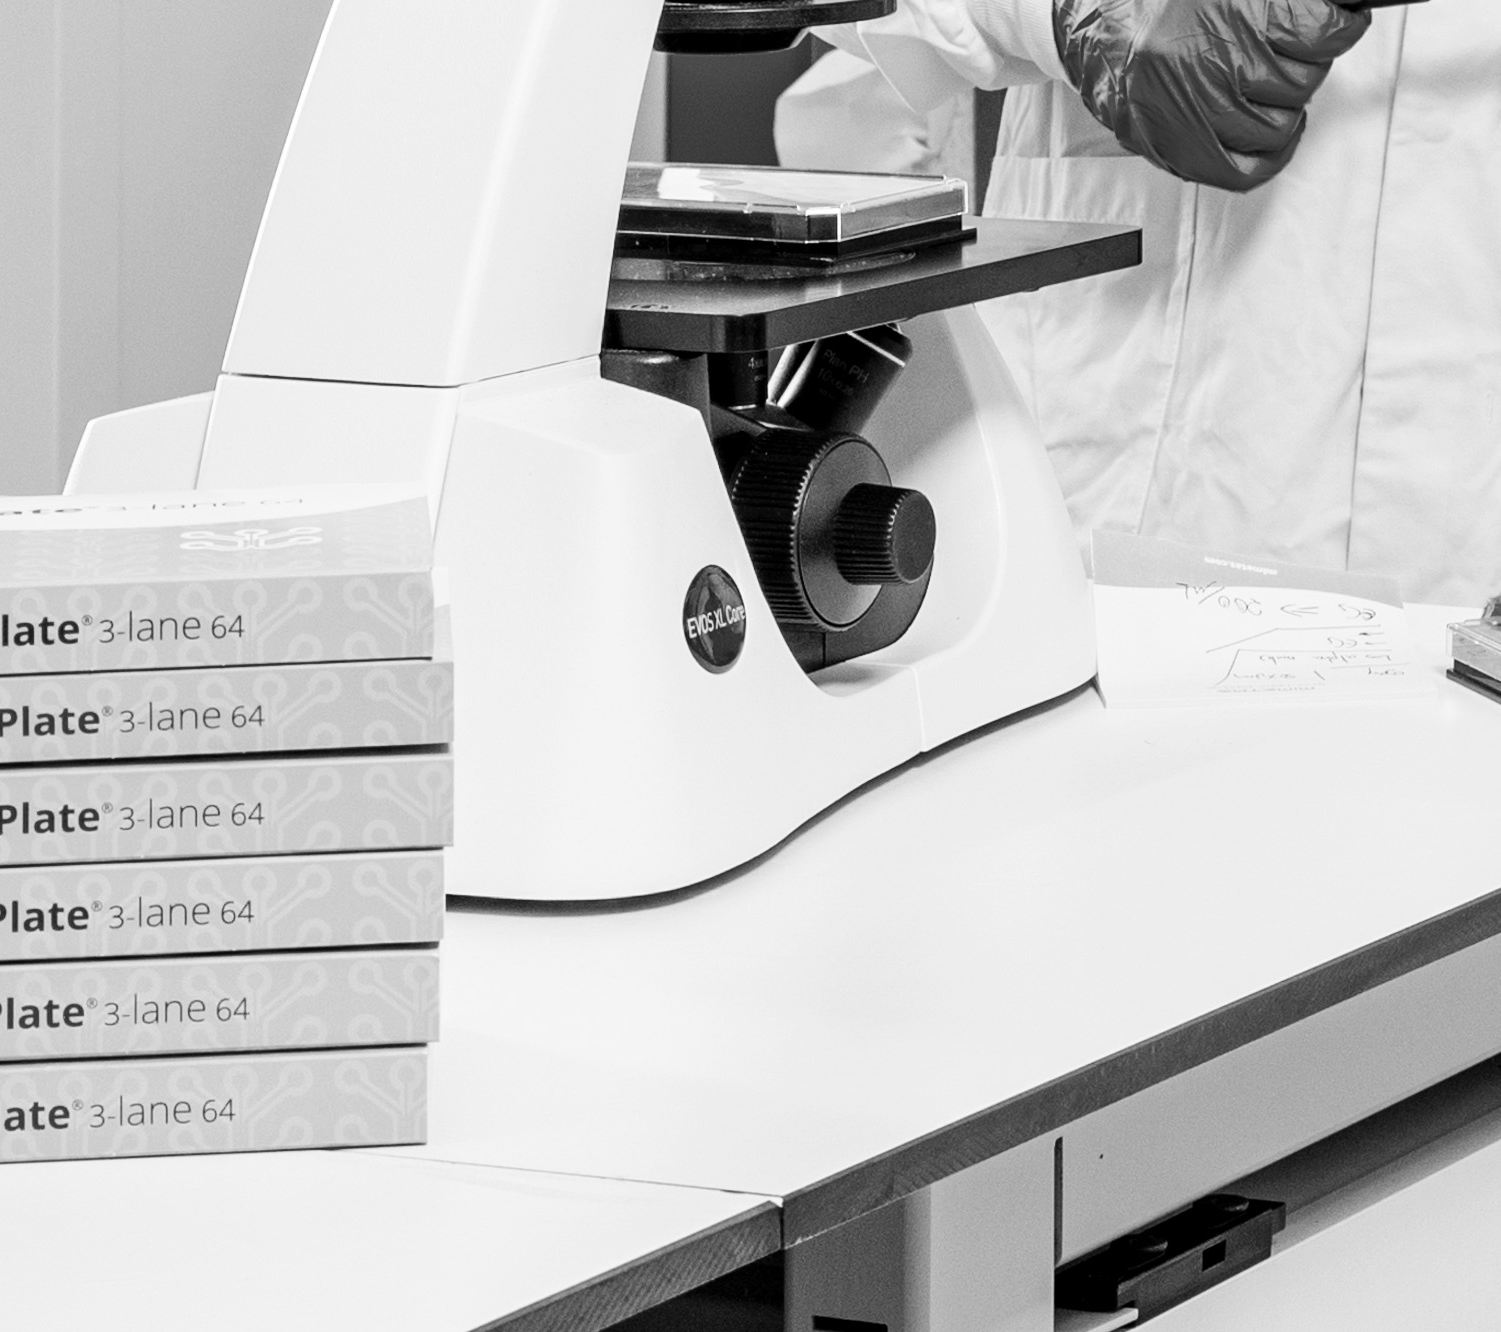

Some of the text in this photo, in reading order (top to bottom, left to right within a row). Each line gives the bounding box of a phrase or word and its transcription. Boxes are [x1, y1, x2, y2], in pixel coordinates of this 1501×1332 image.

[1204, 555, 1279, 576] mimetas.com
[100, 611, 202, 644] 3-lane
[211, 614, 245, 640] 64
[687, 604, 746, 639] EVOS XL Core
[120, 701, 221, 734] 3-lane
[231, 704, 265, 729] 64
[120, 797, 221, 831] 3-lane
[231, 802, 265, 827] 64
[109, 896, 211, 930] 3-lane
[221, 899, 255, 925] 64
[104, 993, 206, 1027] 3-lane
[216, 996, 250, 1022] 64
[90, 1094, 192, 1129] 3-lane
[202, 1098, 236, 1124] 64
